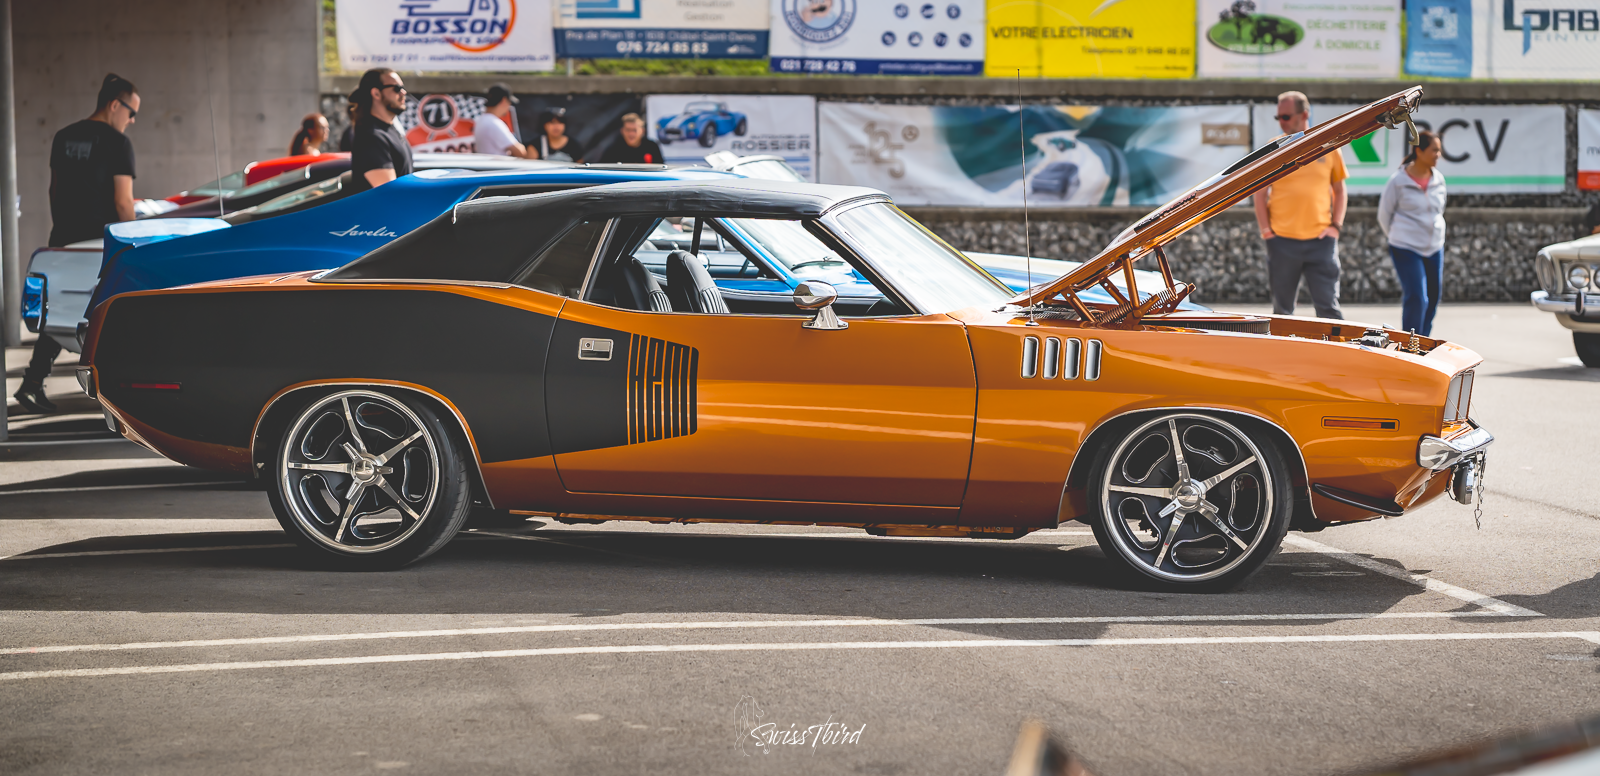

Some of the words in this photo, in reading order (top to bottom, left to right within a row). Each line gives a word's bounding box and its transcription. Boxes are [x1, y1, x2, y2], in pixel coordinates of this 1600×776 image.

[392, 19, 508, 34] BOSSON
[1307, 18, 1387, 30] DÉCHETTERIE
[600, 30, 623, 40] Plan
[991, 25, 1038, 39] VOTRE
[1042, 25, 1134, 39] ELECTRICIEN
[616, 41, 643, 54] 076
[645, 41, 670, 53] 724
[672, 41, 690, 54] 85
[1326, 40, 1380, 50] DOMICILE
[780, 59, 801, 71] 021
[424, 101, 451, 123] 71
[731, 140, 810, 151] ROSSIER
[329, 224, 398, 238] Javelin
